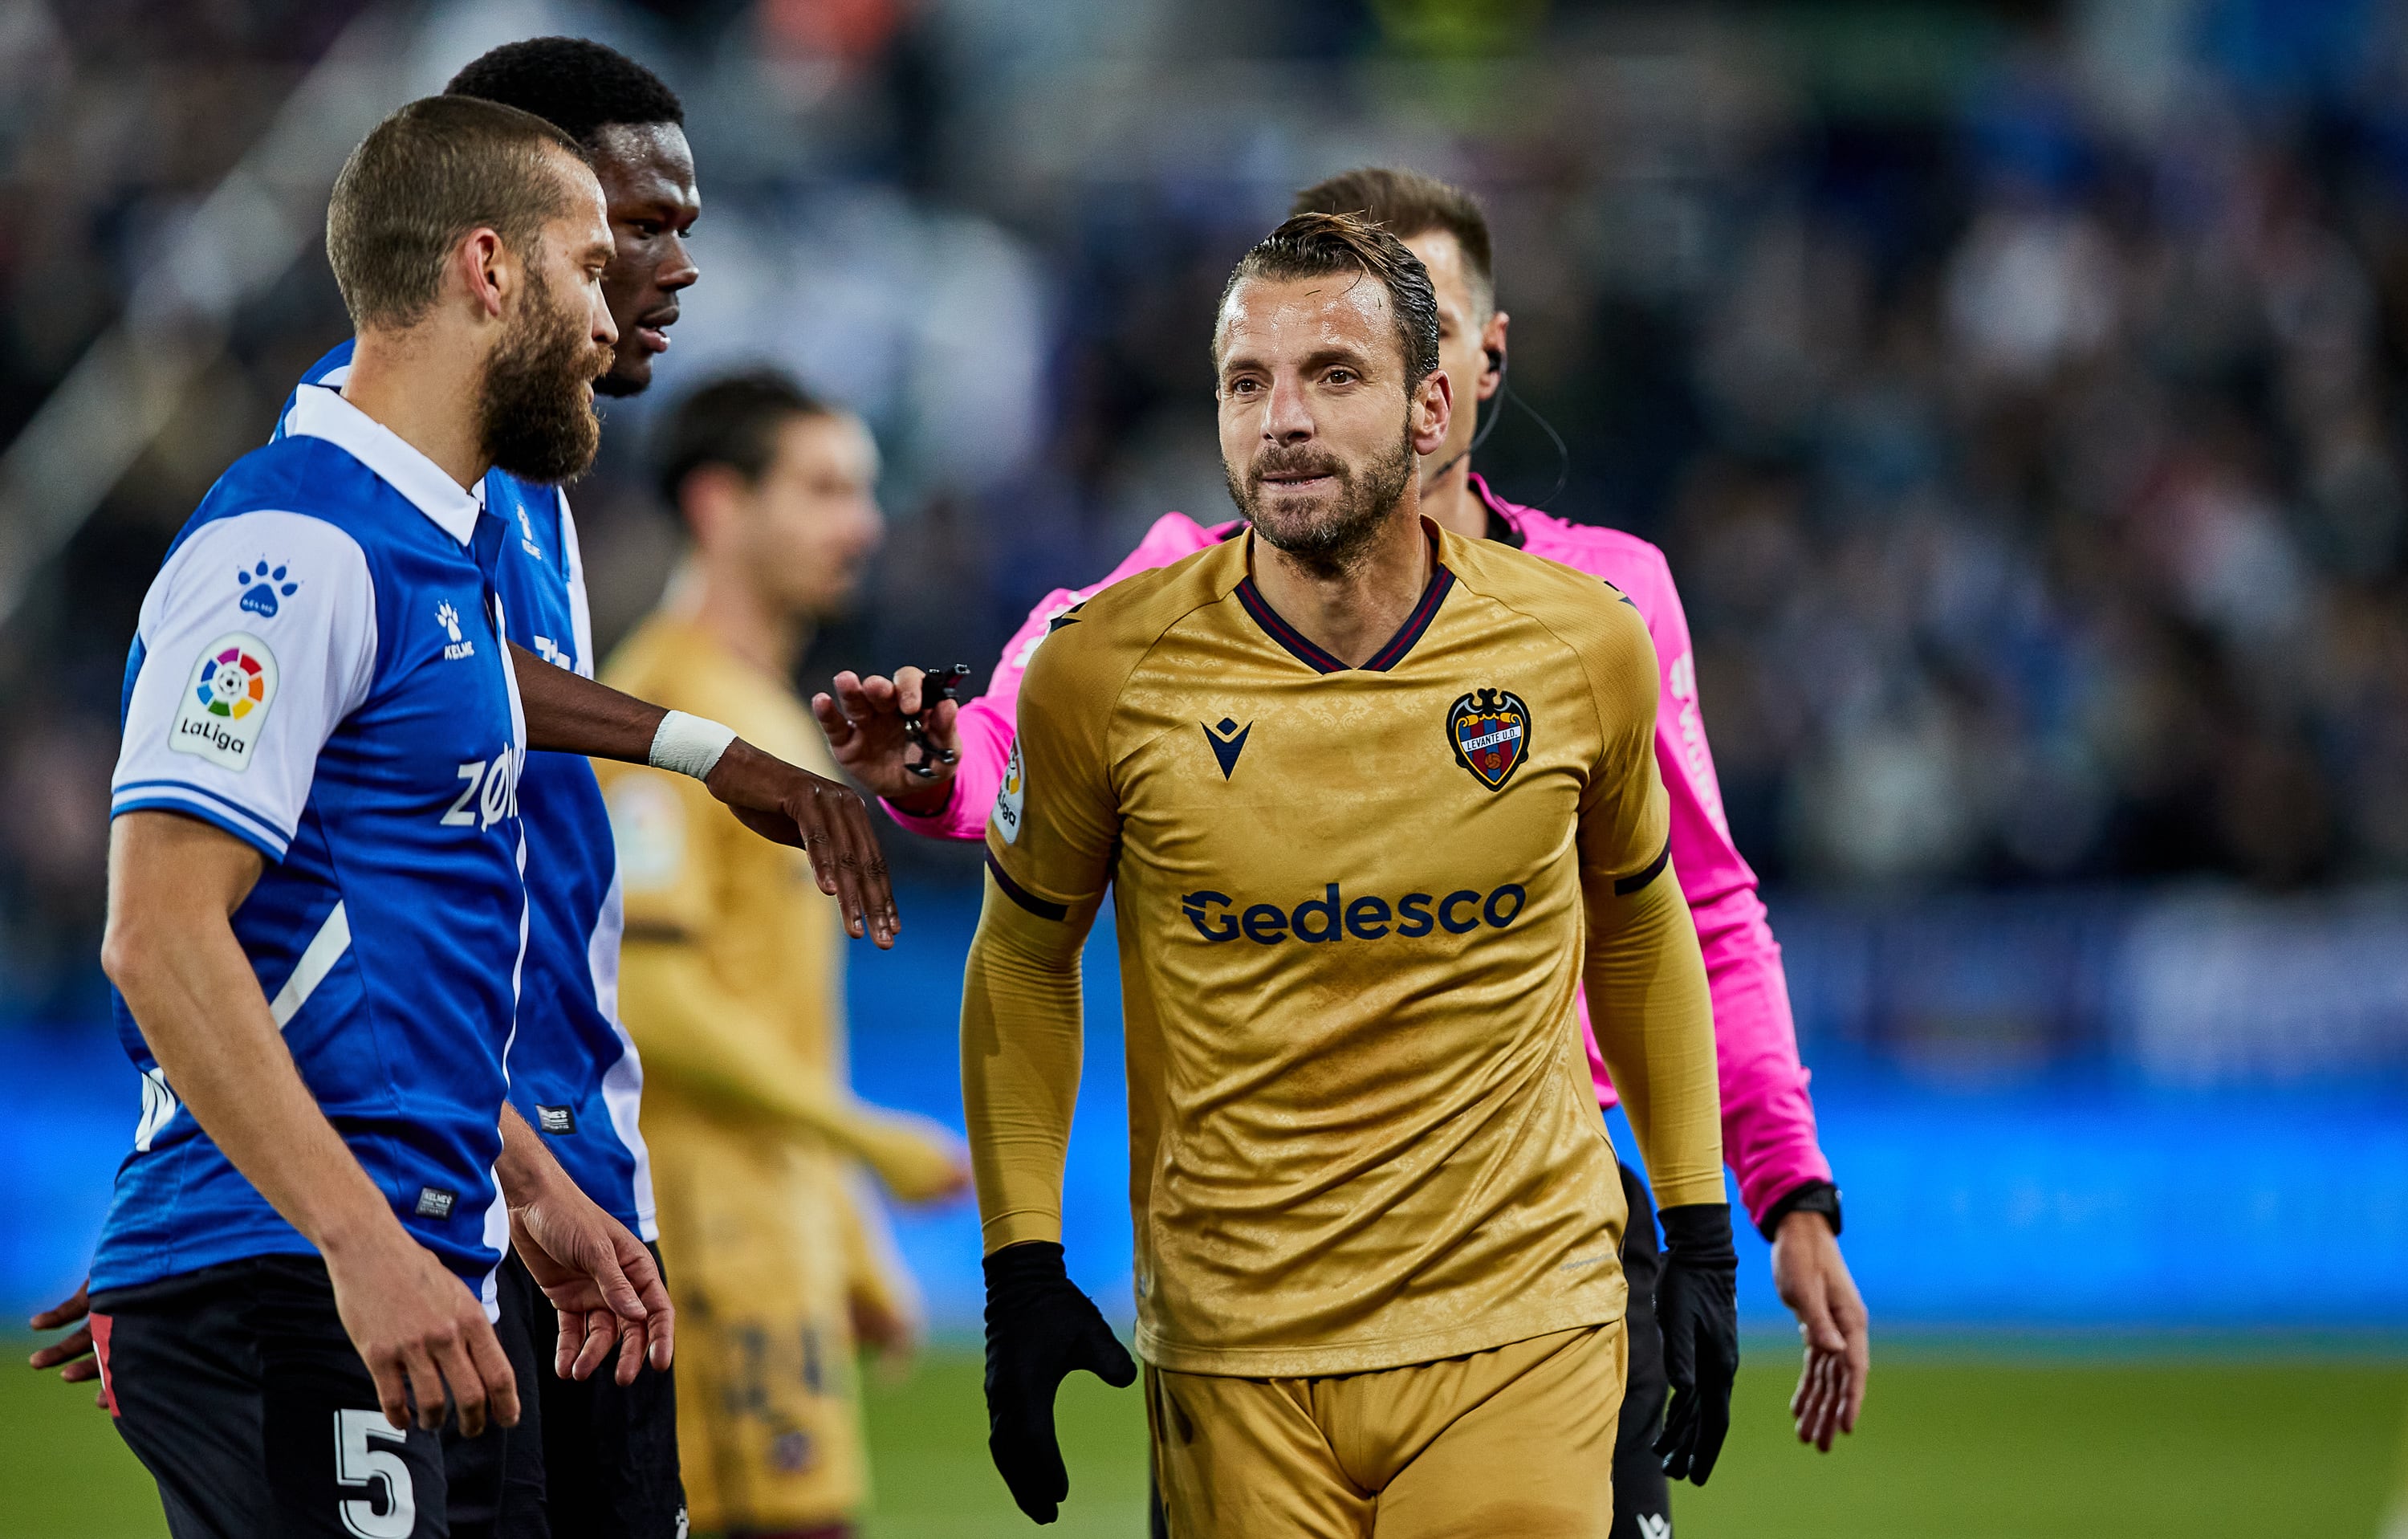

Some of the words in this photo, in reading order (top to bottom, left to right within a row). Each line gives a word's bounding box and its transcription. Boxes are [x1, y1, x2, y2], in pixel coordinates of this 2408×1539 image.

[444, 640, 475, 661] KELME
[181, 717, 245, 754] LaLiga
[1466, 733, 1499, 751] LEVANTE
[1502, 728, 1518, 739] U.D.
[1182, 882, 1526, 946] Gedesco
[333, 1408, 416, 1539] 5
